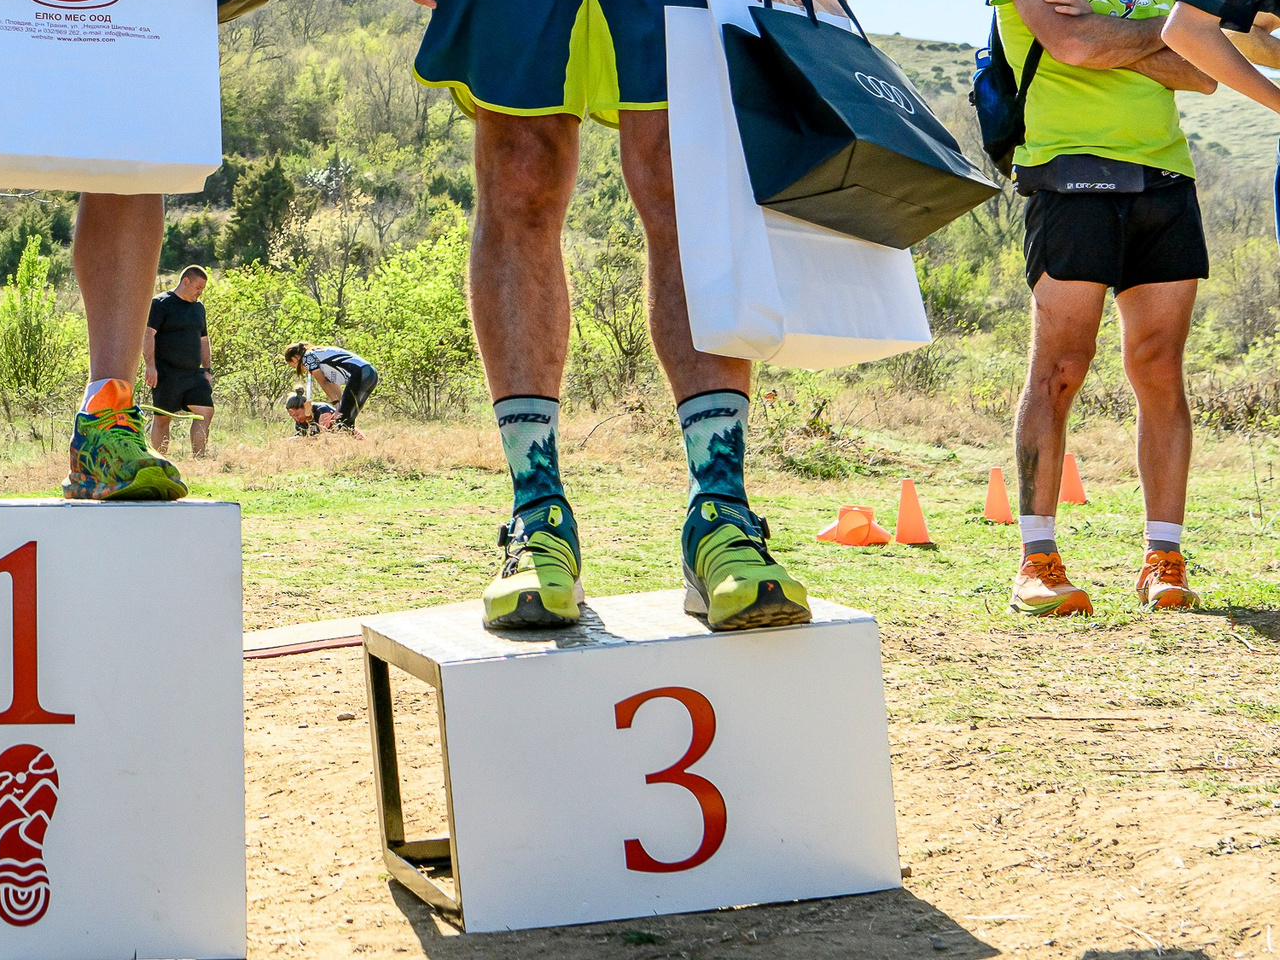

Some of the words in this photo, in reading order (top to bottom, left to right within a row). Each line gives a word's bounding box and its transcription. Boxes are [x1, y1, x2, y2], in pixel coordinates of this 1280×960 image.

[35, 12, 62, 21] ЕЛКО
[65, 13, 87, 22] МЕС
[89, 14, 112, 23] ООД
[498, 412, 552, 429] CRAZY
[614, 686, 727, 873] 3
